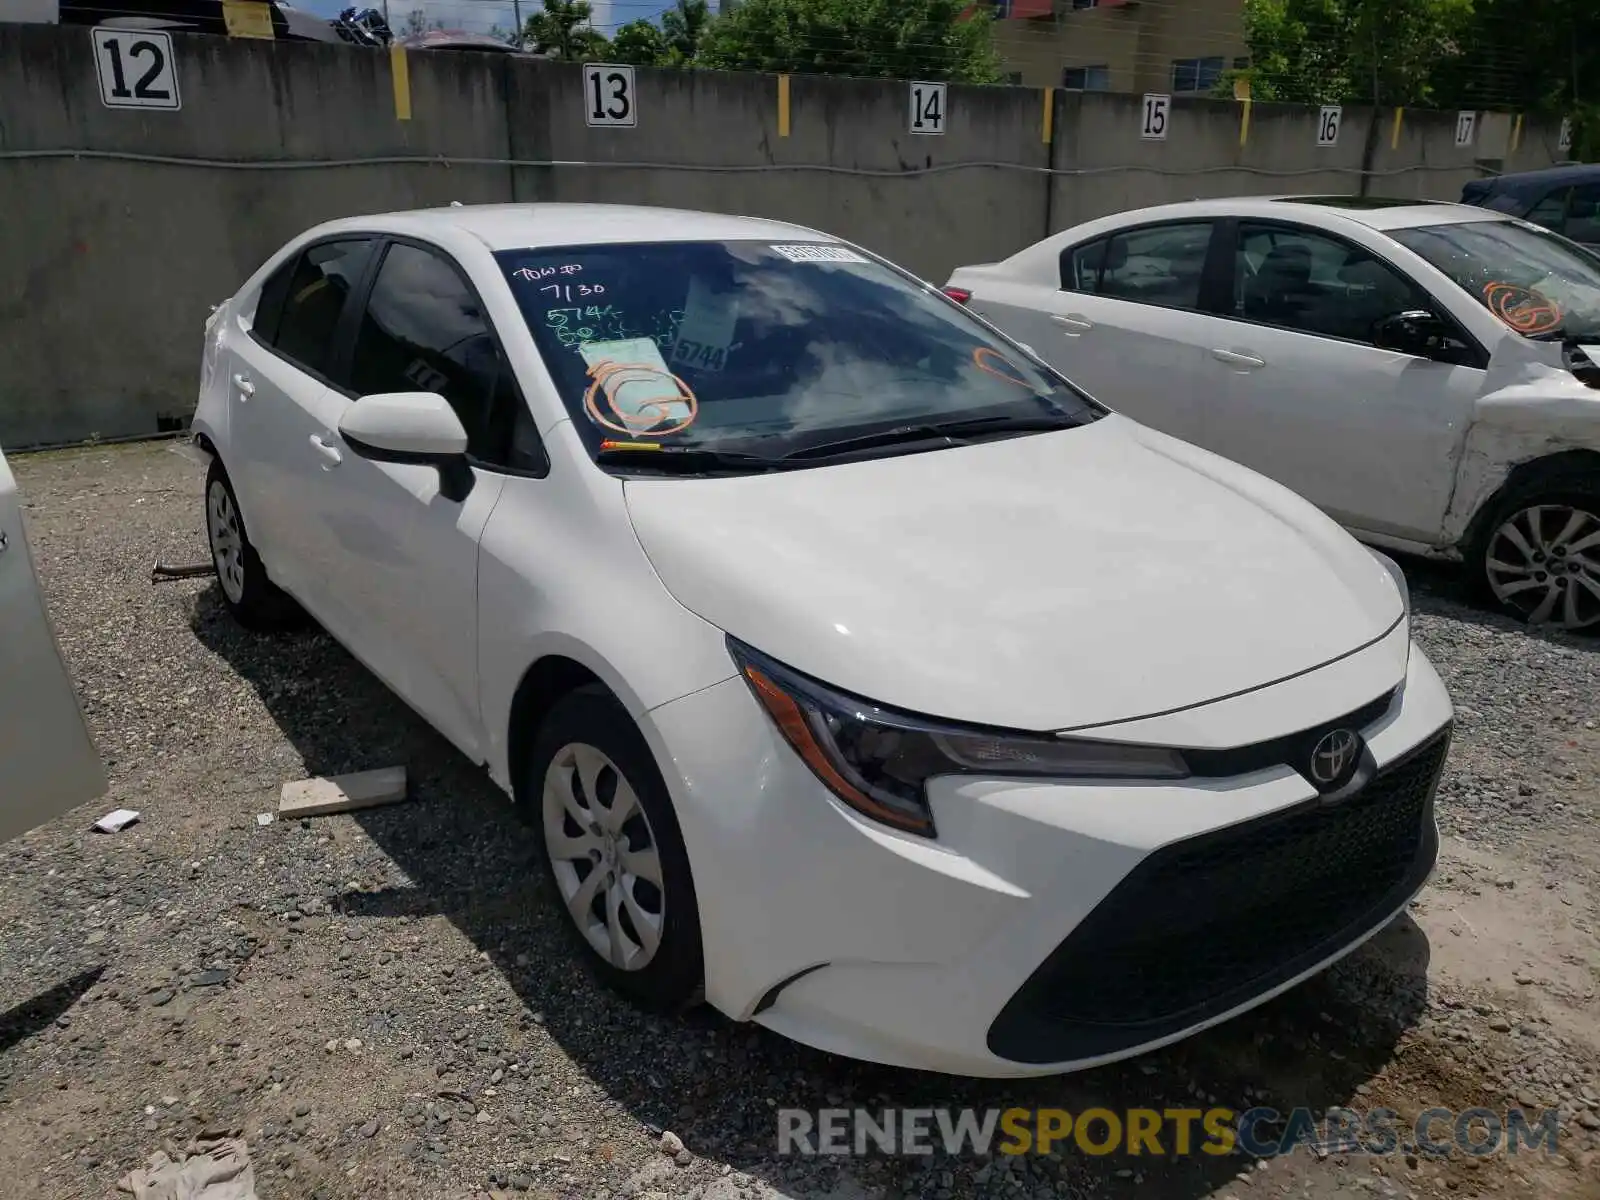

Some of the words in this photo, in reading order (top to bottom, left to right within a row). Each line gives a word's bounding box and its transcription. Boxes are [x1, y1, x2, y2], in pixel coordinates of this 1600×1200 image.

[103, 38, 170, 100] 12
[590, 71, 630, 120] 13
[913, 88, 942, 129] 14
[1144, 100, 1165, 134] 15
[1320, 111, 1338, 141] 16
[1457, 116, 1473, 143] 17
